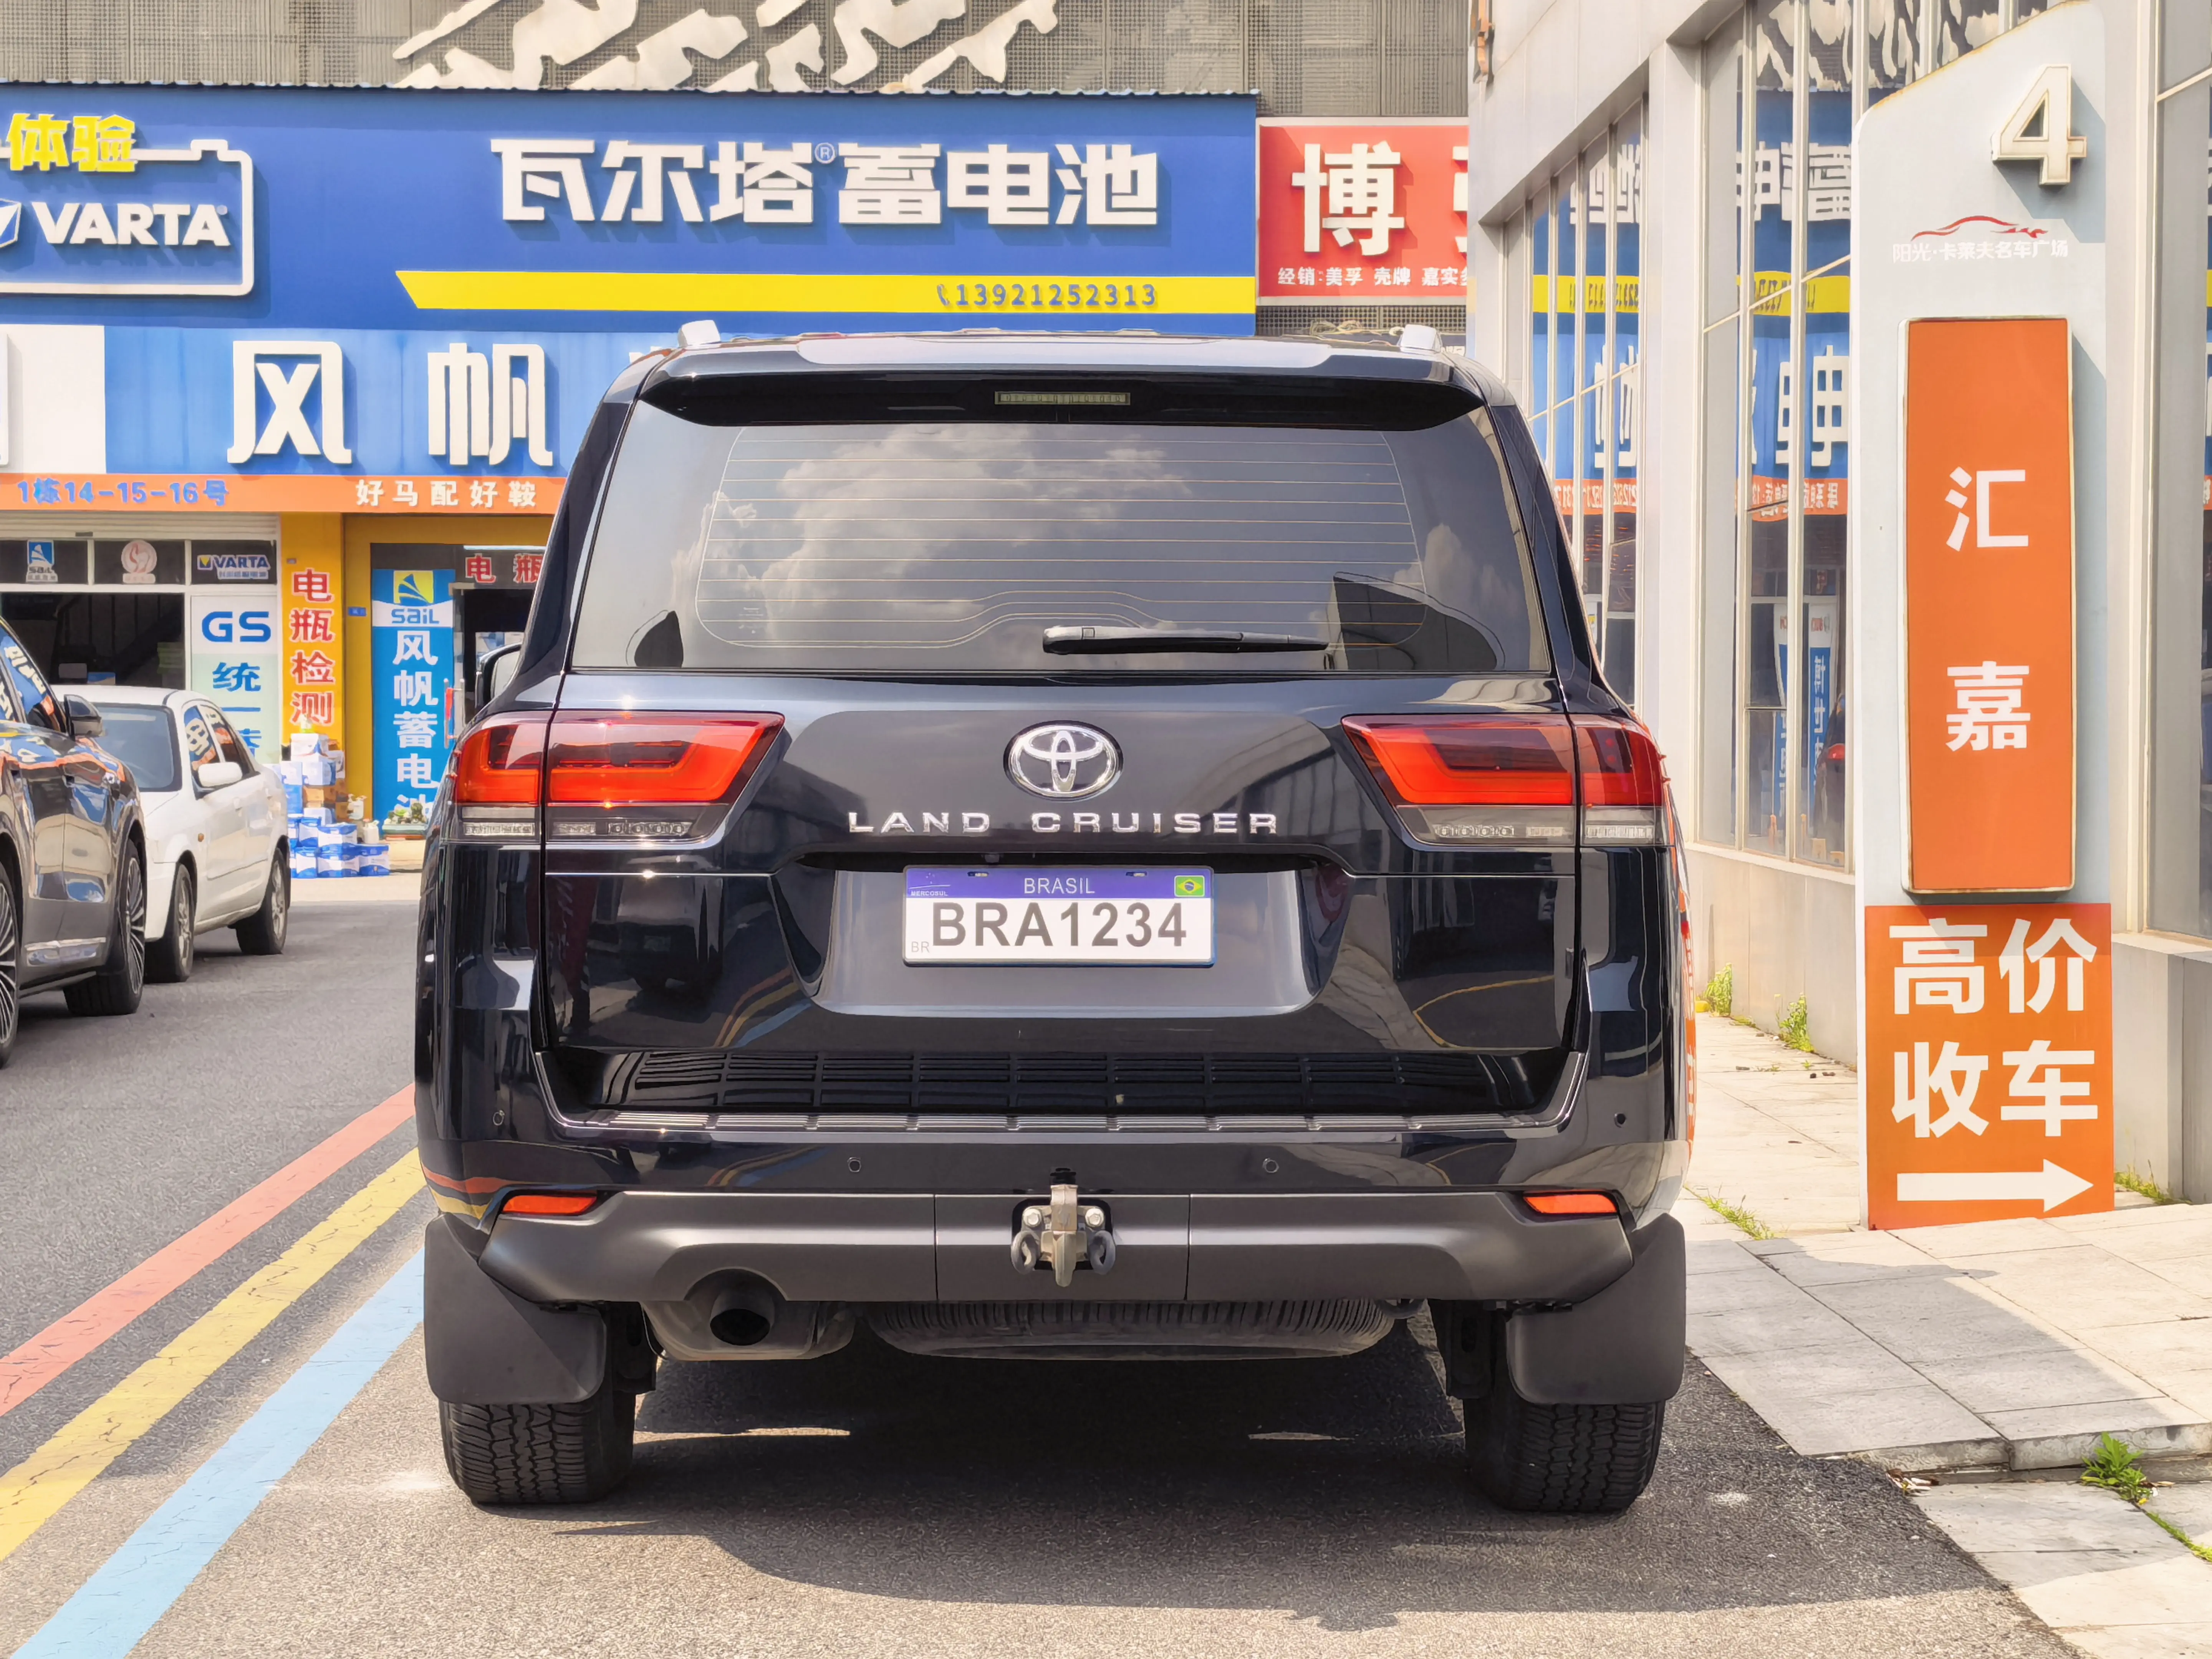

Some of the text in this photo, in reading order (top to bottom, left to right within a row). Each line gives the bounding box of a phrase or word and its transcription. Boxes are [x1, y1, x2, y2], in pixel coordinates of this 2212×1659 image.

[7, 113, 137, 172] 体验
[1991, 63, 2086, 185] 4
[1291, 140, 1469, 256] 博
[31, 202, 231, 247] VARTA
[955, 283, 1156, 306] 13921252313
[1374, 267, 1411, 286] 壳牌
[227, 340, 553, 466] 风帆
[356, 479, 537, 508] 好马配好鞍
[214, 556, 269, 568] VARTA
[465, 553, 545, 583] 电瓶
[202, 611, 271, 642] GS
[289, 568, 335, 727] 电瓶检测
[848, 812, 1277, 834] LAND CRUISER
[1023, 877, 1095, 895] BRASIL
[932, 902, 1187, 947] BRA1234
[911, 941, 930, 953] BR
[1889, 918, 2097, 1015] 高价
[1891, 1040, 2098, 1138] 收车
